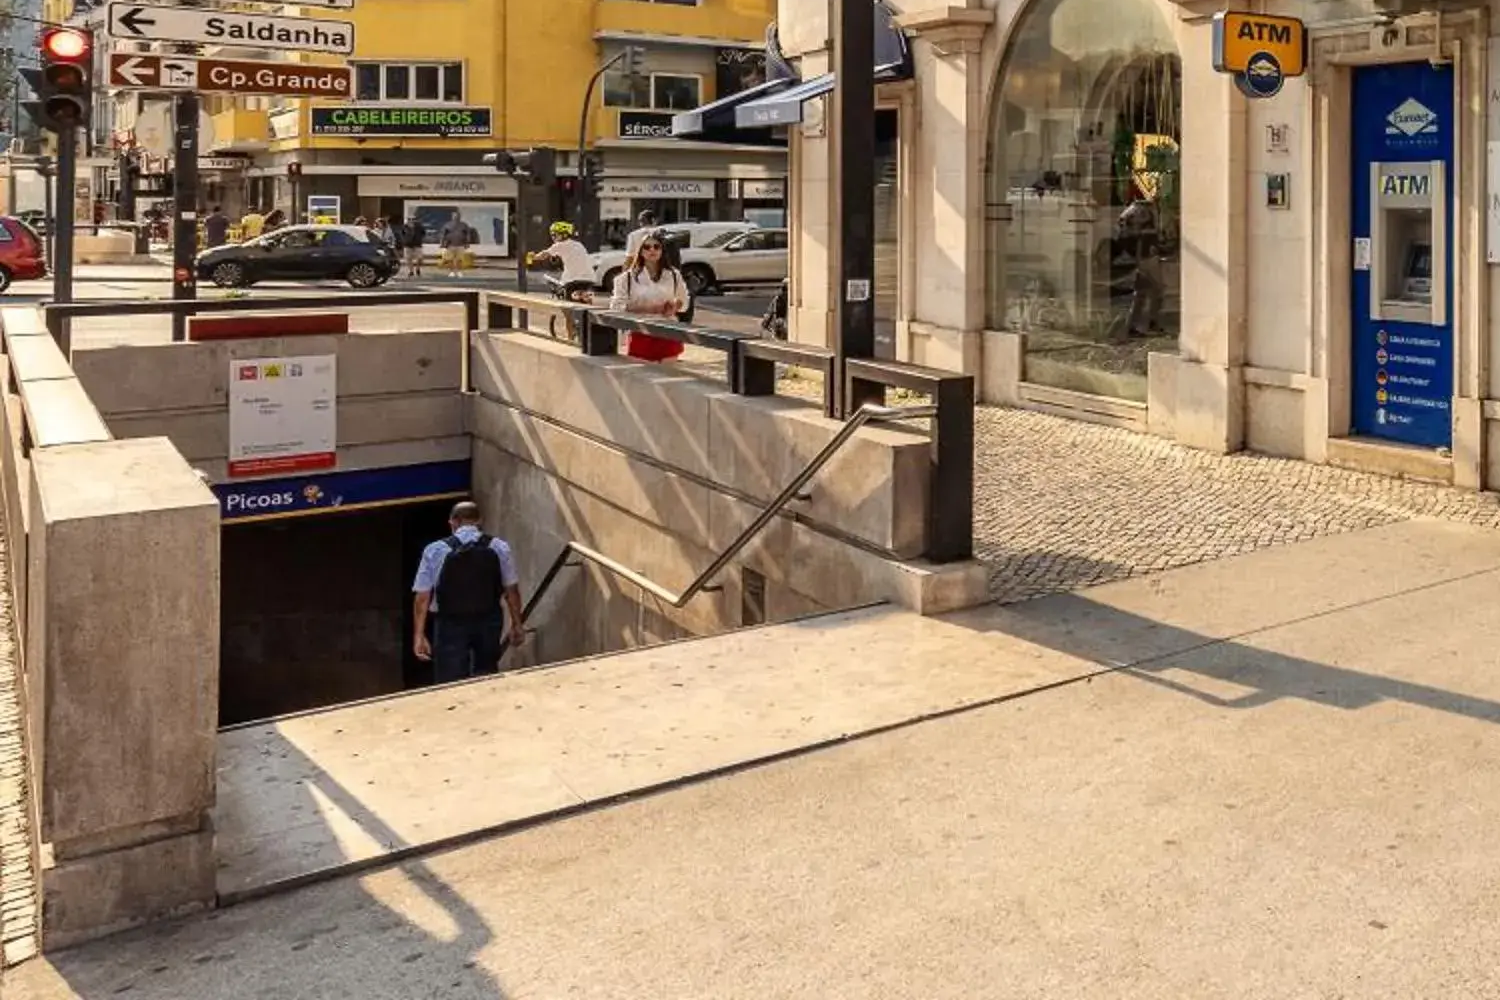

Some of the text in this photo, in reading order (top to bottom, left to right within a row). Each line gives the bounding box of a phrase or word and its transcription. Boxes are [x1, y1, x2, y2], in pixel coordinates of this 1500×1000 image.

[205, 17, 347, 47] Saldanha
[1237, 21, 1291, 44] ATM
[209, 66, 348, 91] Cp.Grande
[332, 110, 473, 125] CABELEIREIROS
[1383, 174, 1430, 195] ATM
[226, 491, 294, 511] Picoas
